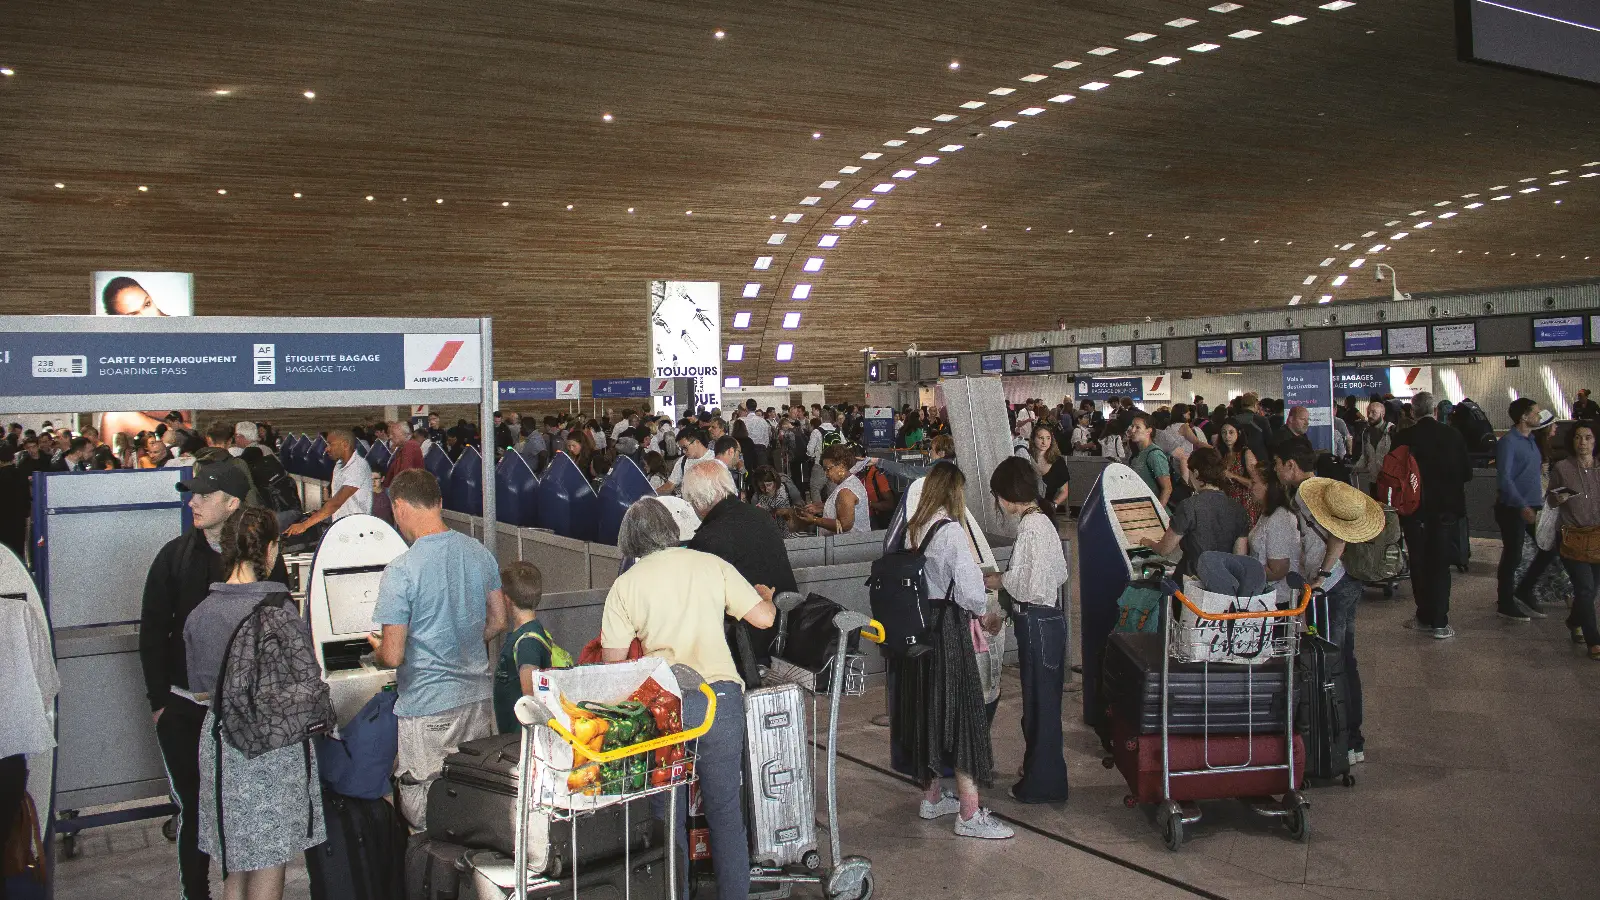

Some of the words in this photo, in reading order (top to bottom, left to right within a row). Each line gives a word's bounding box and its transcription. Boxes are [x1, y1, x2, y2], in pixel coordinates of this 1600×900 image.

[258, 346, 271, 354] AF
[99, 356, 136, 364] CARTE
[138, 355, 238, 364] D'EMBARQUEMENT
[285, 353, 337, 363] ÉTIQUETTE
[339, 354, 381, 362] BAGAGE
[99, 367, 158, 376] BOARDING
[161, 367, 188, 375] PASS
[285, 365, 334, 373] BAGGAGE
[656, 366, 718, 377] TOUJOURS
[870, 365, 877, 378] 4
[1349, 381, 1383, 389] DROP-OFF
